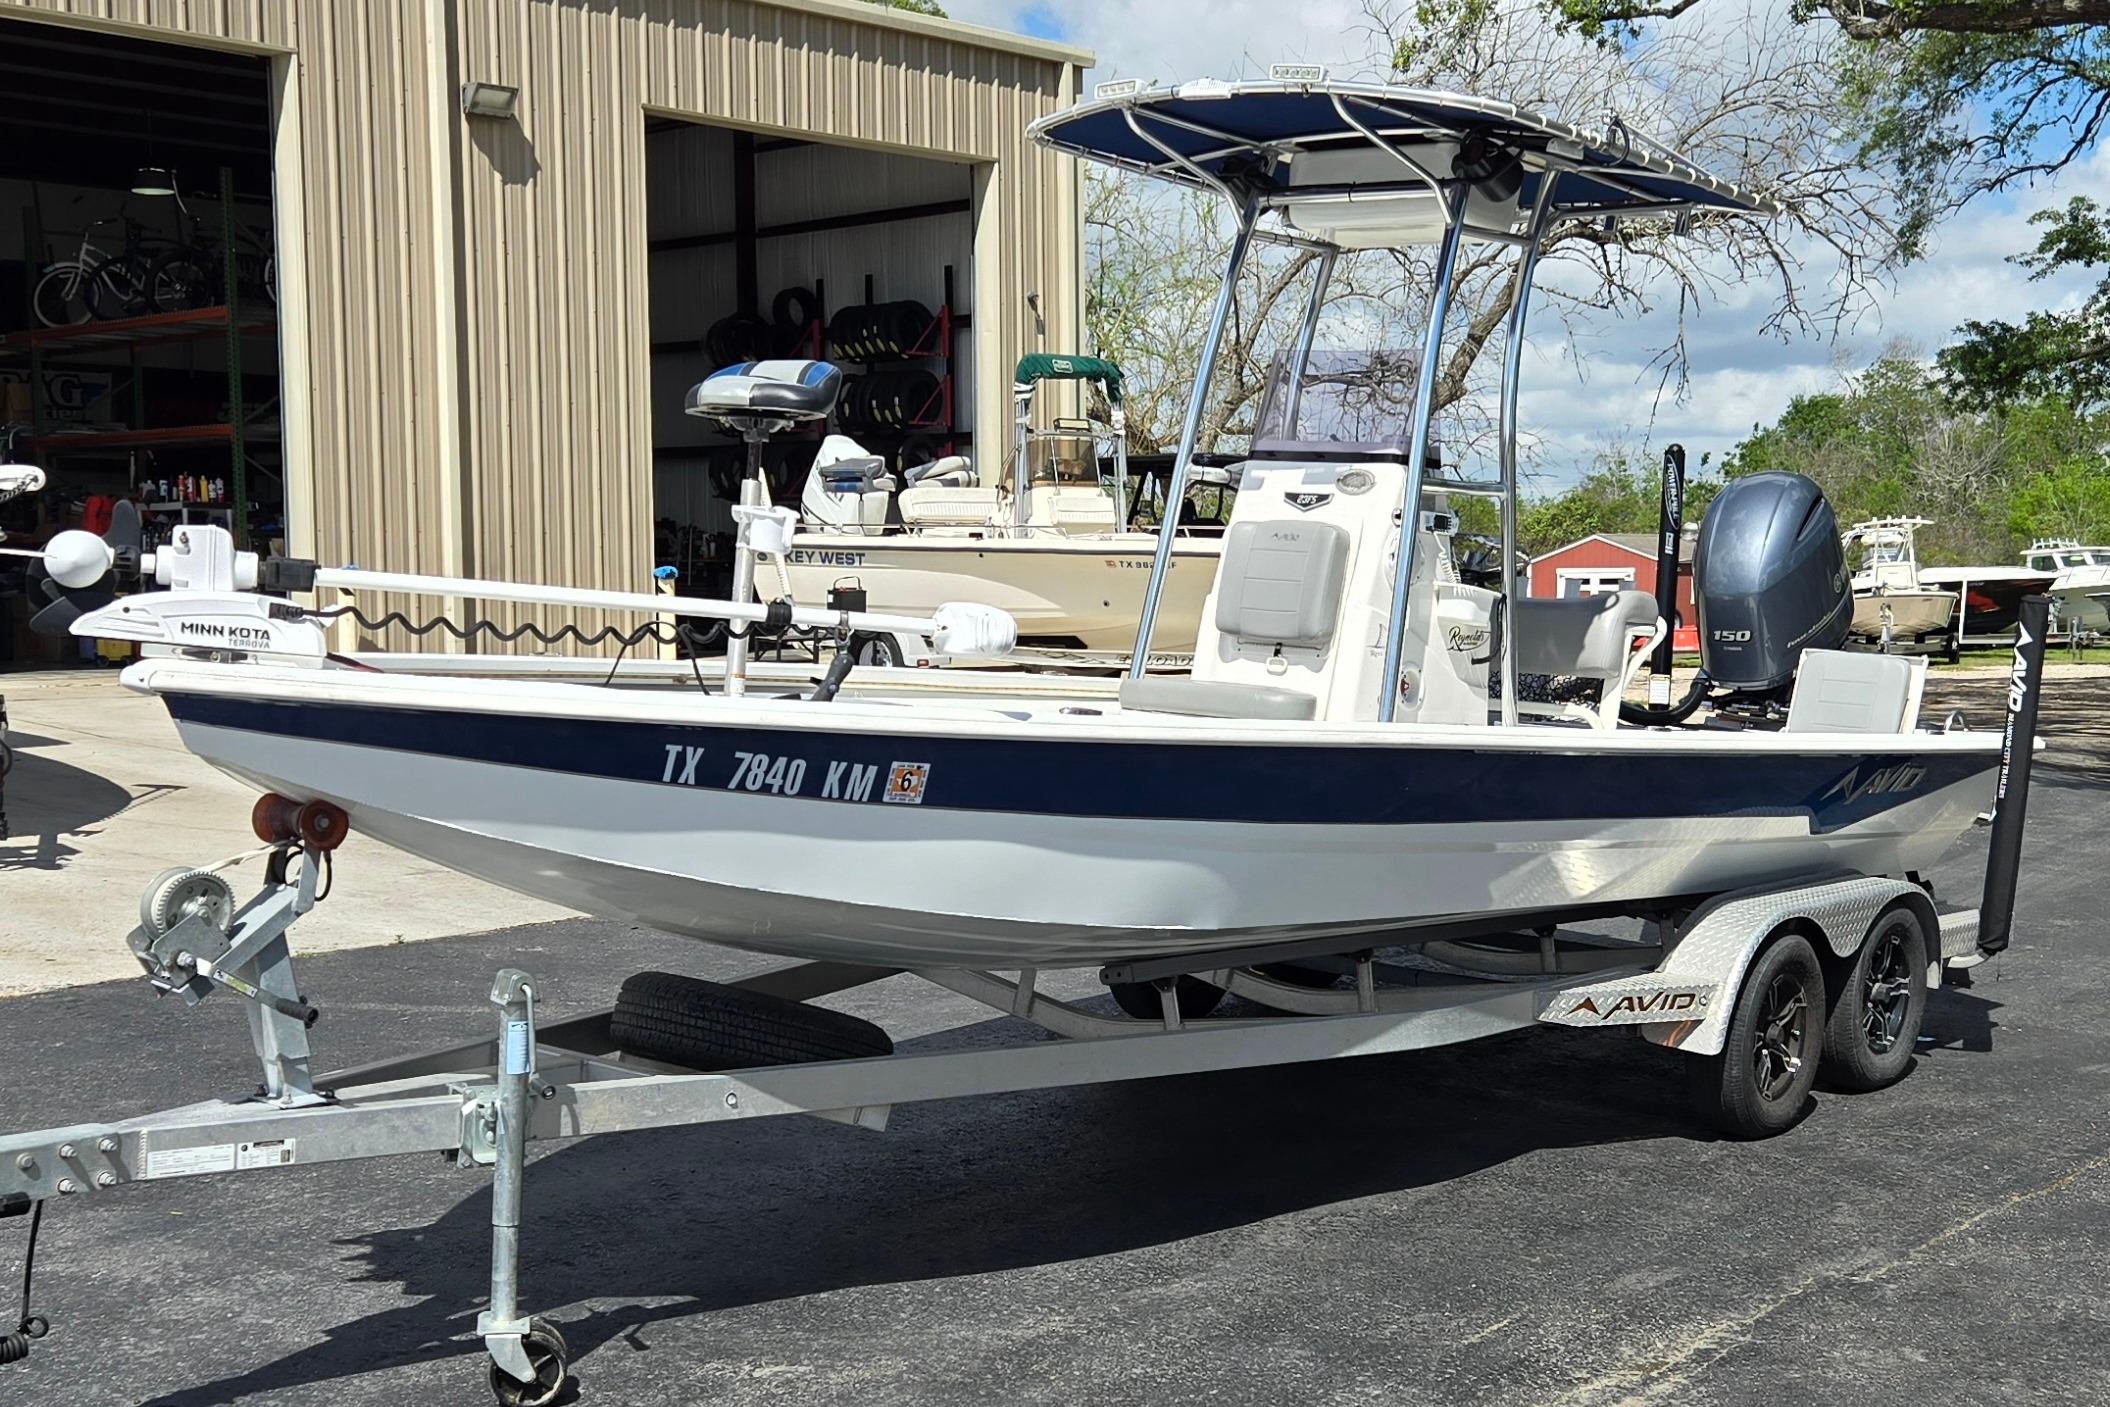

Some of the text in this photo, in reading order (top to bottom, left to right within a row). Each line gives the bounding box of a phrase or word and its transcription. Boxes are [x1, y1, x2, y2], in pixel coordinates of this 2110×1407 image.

[784, 550, 815, 564] KEY
[819, 552, 865, 566] WEST
[1119, 560, 1134, 569] TX
[181, 622, 271, 641] MINN KOTA
[1713, 630, 1751, 642] 150
[228, 639, 270, 649] TERROVA
[1146, 654, 1194, 667] LOAD
[2007, 646, 2028, 713] AVID
[662, 744, 878, 802] TX 7840 KM
[900, 770, 913, 792] 6
[1843, 762, 1927, 805] AVID
[1601, 991, 1696, 1020] AVID
